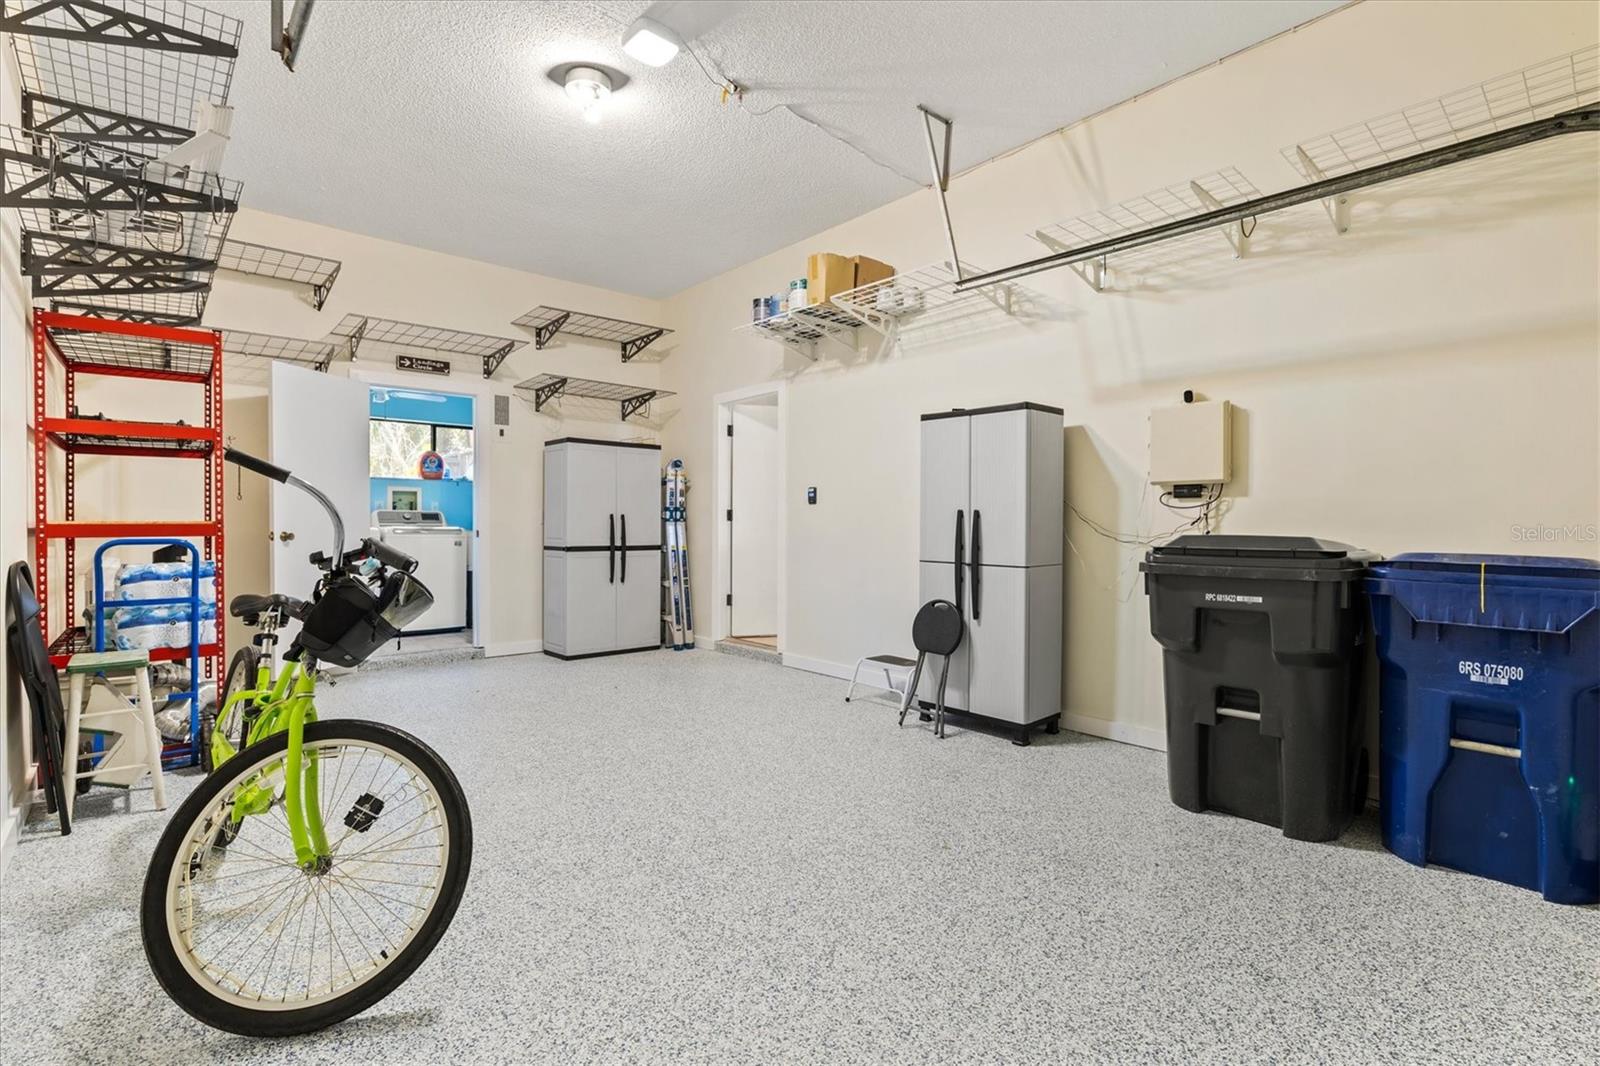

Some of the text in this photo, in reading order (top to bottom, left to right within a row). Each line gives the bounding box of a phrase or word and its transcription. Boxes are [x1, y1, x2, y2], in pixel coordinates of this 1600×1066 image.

[1205, 593, 1216, 601] RPC
[1458, 661, 1524, 681] 6RS 075080
